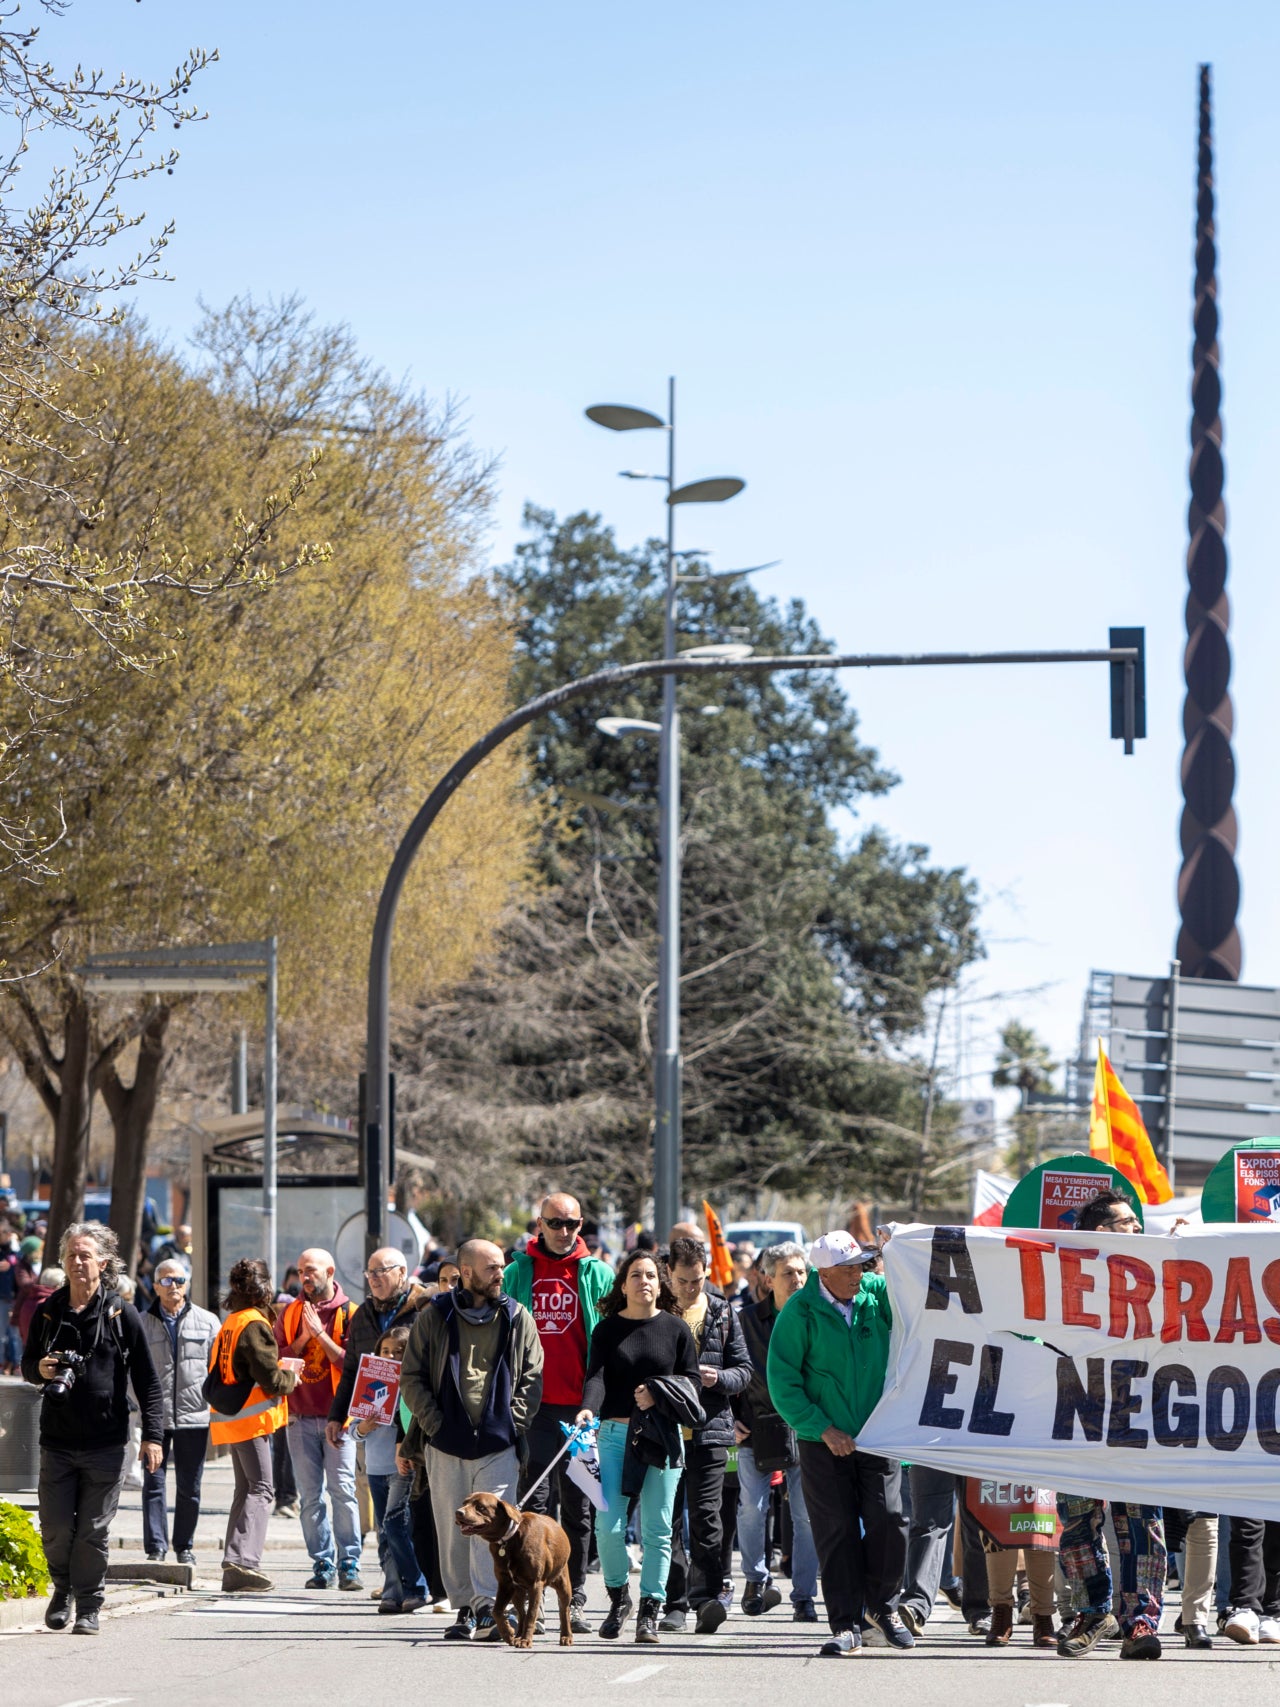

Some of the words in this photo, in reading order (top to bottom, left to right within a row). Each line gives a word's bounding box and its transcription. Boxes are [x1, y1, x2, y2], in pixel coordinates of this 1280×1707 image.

[1240, 1169, 1254, 1178] ELS
[1256, 1169, 1279, 1178] PISOS
[1045, 1176, 1063, 1184] MESA
[1064, 1177, 1109, 1187] D'EMERGÈNCIA
[1244, 1178, 1265, 1186] FONS
[1052, 1185, 1062, 1198] A
[1064, 1186, 1099, 1200] ZERO
[925, 1227, 983, 1314] A
[532, 1293, 573, 1310] STOP
[533, 1311, 572, 1321] ESAHUCIOS
[918, 1339, 1015, 1436] EL
[1010, 1520, 1045, 1532] LAPAH
